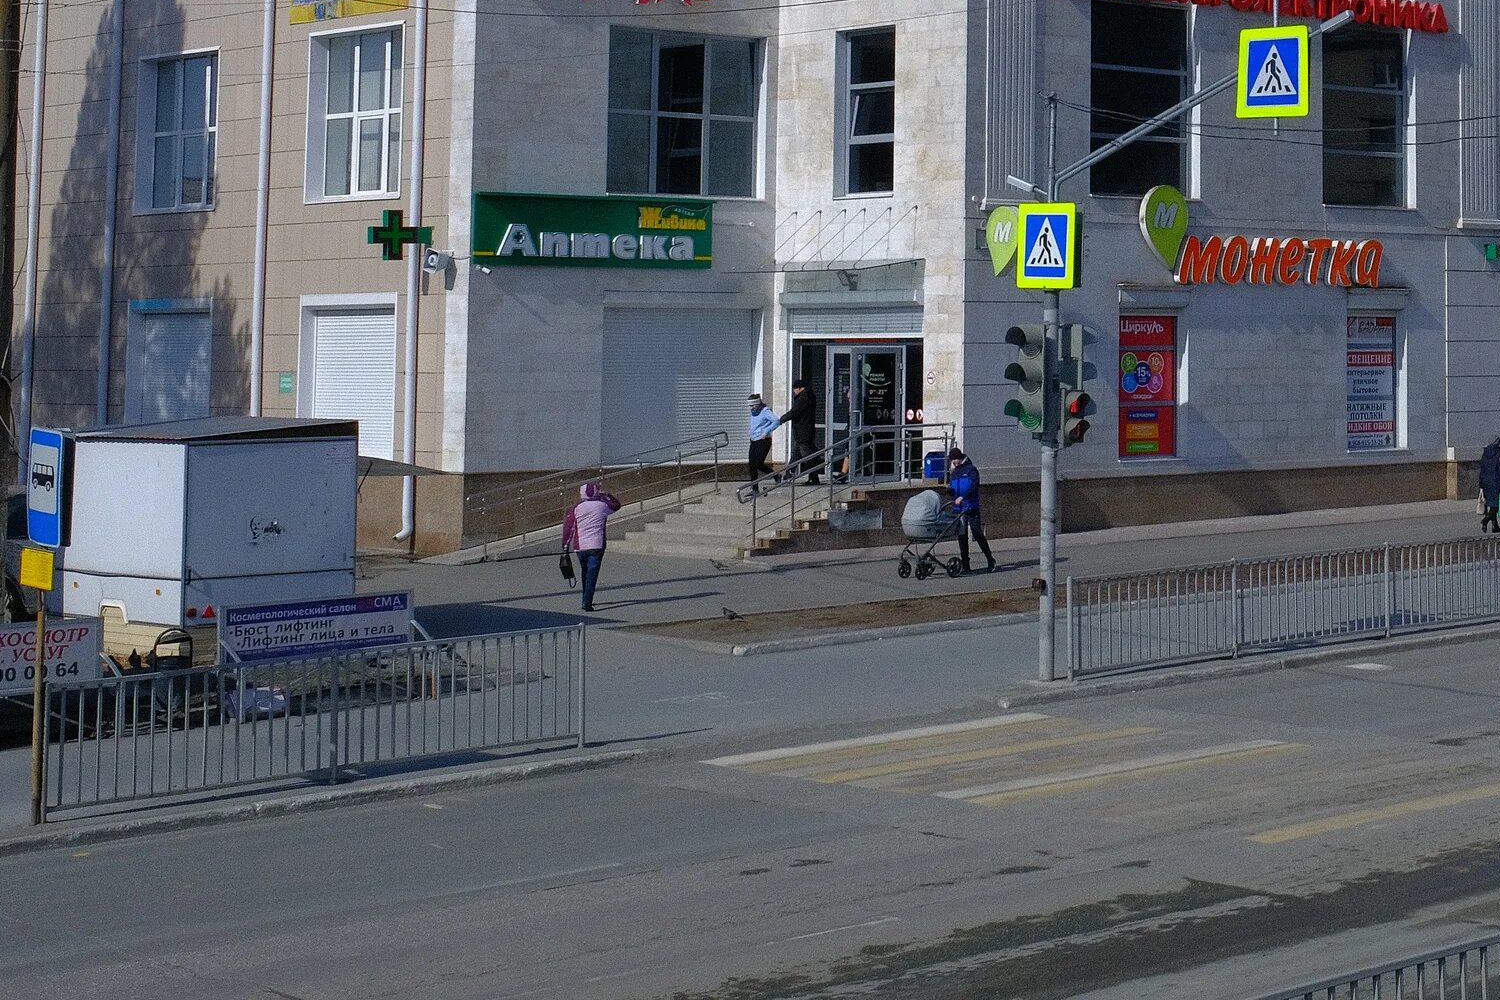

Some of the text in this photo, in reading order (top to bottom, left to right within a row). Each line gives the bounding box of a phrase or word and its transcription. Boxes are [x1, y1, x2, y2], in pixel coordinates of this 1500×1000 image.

[496, 223, 695, 261] Аптека
[1120, 319, 1164, 335] Циркуль
[1347, 354, 1392, 365] СВЕЩЕНИЕ
[1352, 386, 1379, 394] бытовое
[1347, 403, 1386, 411] НАТЯЖНЫЕ
[1350, 411, 1383, 420] ПОТОЛКИ
[1348, 421, 1393, 432] ИДКИЕ ОБОИ
[229, 604, 327, 623] Косметологический
[328, 603, 357, 615] салон
[374, 595, 401, 608] СМА
[234, 618, 334, 638] Бюст лифтинг
[242, 632, 305, 649] Лифтинг
[310, 628, 345, 642] лица
[351, 628, 358, 638] и
[364, 623, 395, 635] тела
[12, 644, 69, 663] УСУГ
[55, 660, 79, 677] 64
